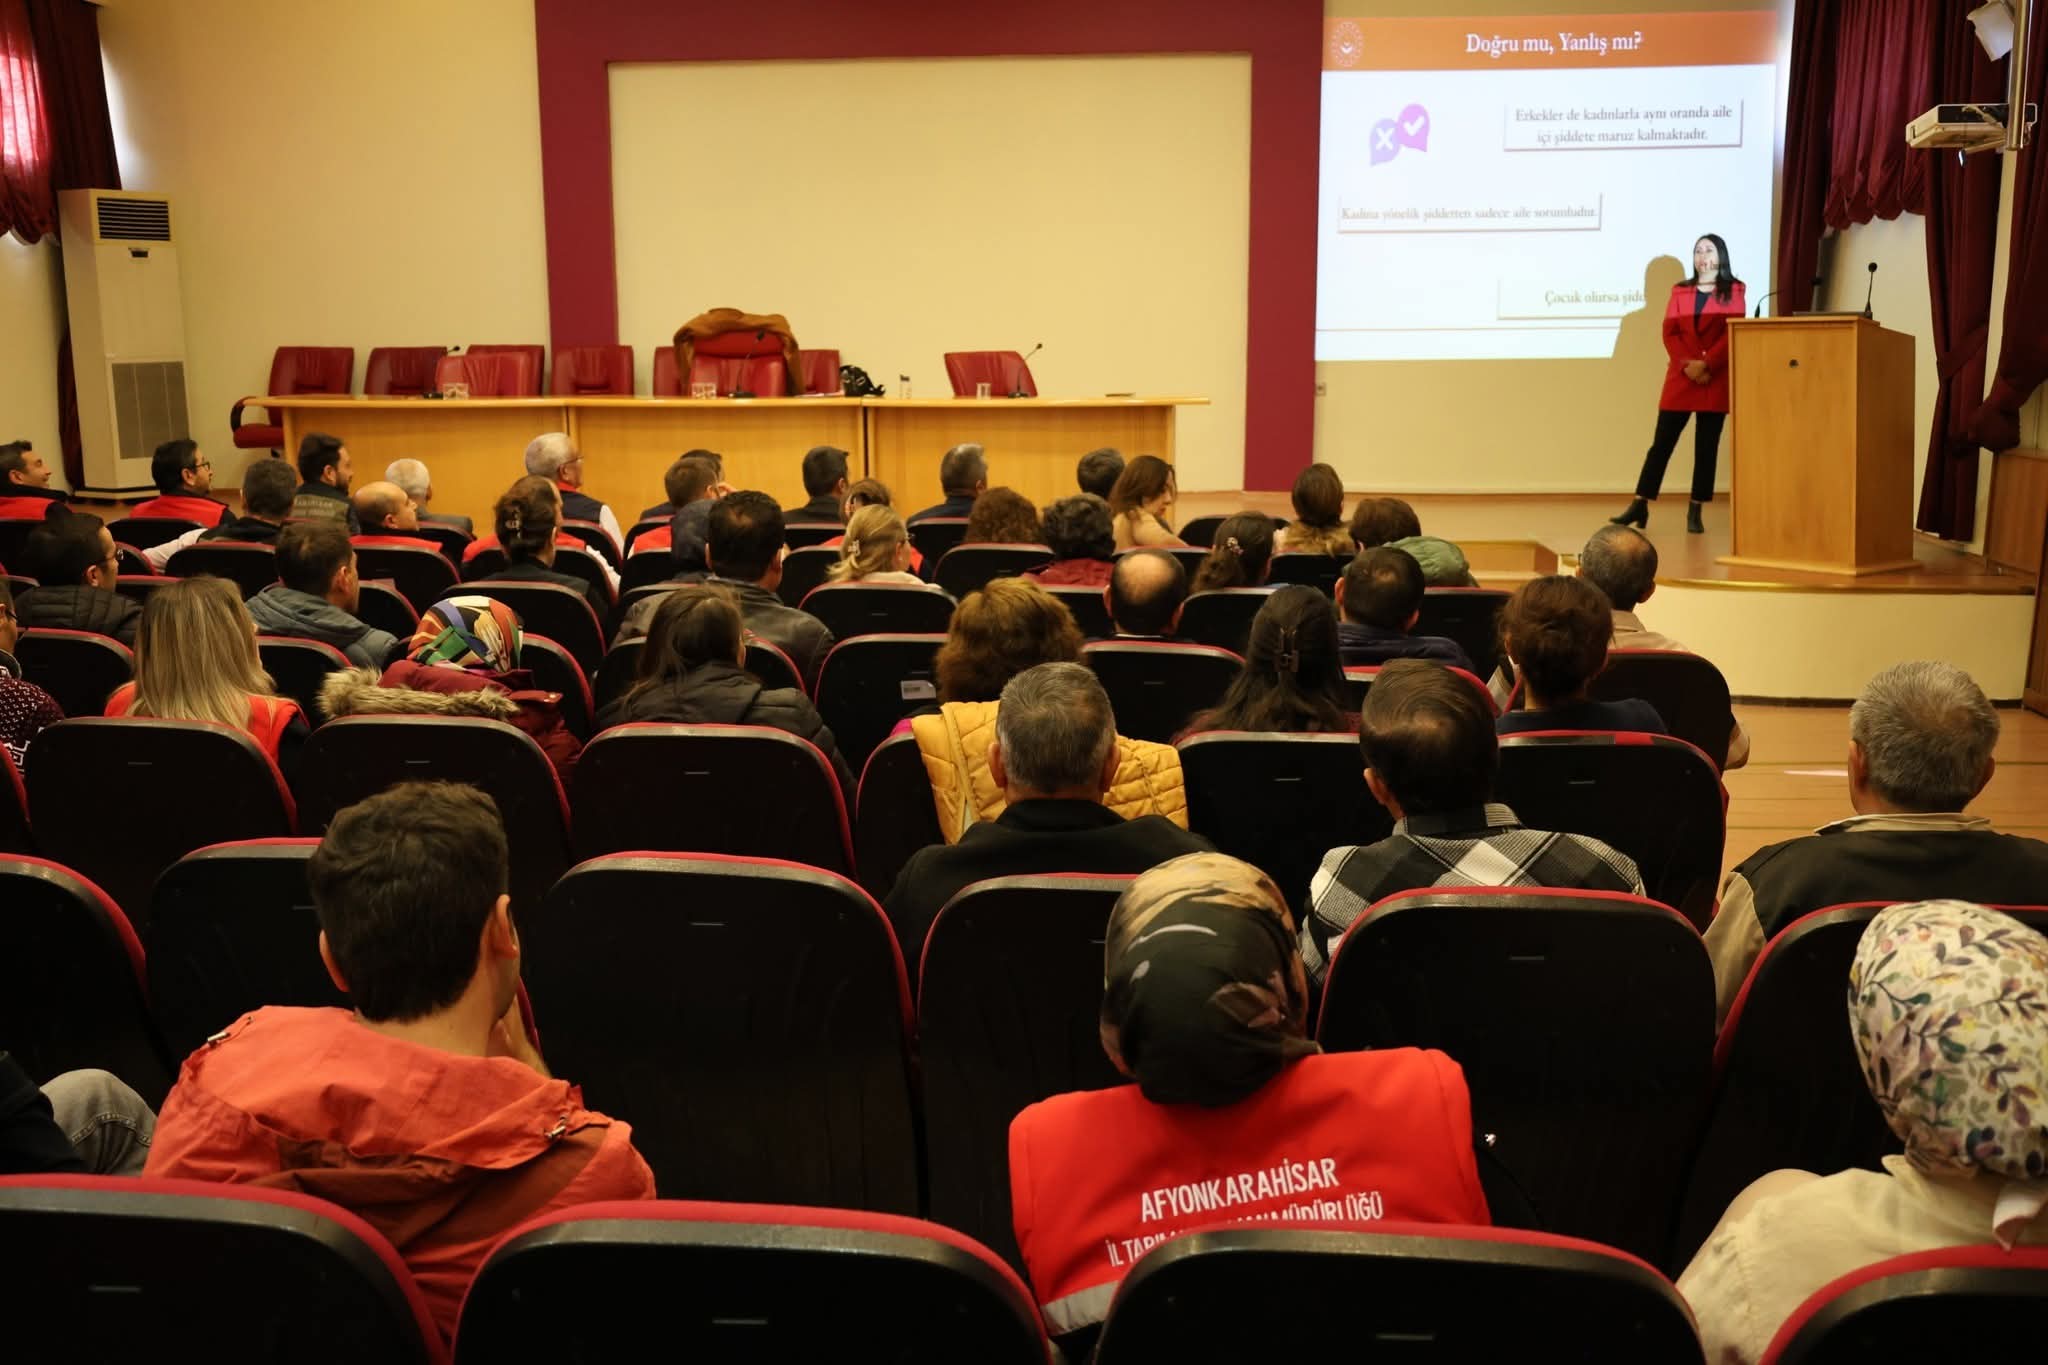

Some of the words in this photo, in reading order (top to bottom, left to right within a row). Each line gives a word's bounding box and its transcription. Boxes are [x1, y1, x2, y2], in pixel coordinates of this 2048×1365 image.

[1466, 33, 1519, 58] Doğru
[1523, 37, 1554, 54] mu,
[1559, 32, 1608, 56] Yanlış
[1612, 31, 1642, 50] mı?
[1515, 107, 1565, 121] Erkekler
[1567, 107, 1580, 121] de
[1583, 106, 1640, 121] kadınlarla
[1643, 107, 1667, 124] aynı
[1670, 105, 1710, 119] oranda
[1712, 105, 1733, 118] aile
[1537, 130, 1551, 146] içi
[1553, 128, 1595, 146] şiddete
[1598, 130, 1635, 142] maruz
[1637, 127, 1708, 141] kalmaktadır.
[1475, 206, 1511, 219] sadece
[1513, 205, 1531, 218] aile
[1545, 289, 1582, 306] Çocuk
[1584, 289, 1619, 304] olursa
[1141, 1158, 1340, 1223] AFYONKARAHİSAR
[1105, 1238, 1124, 1267] İL
